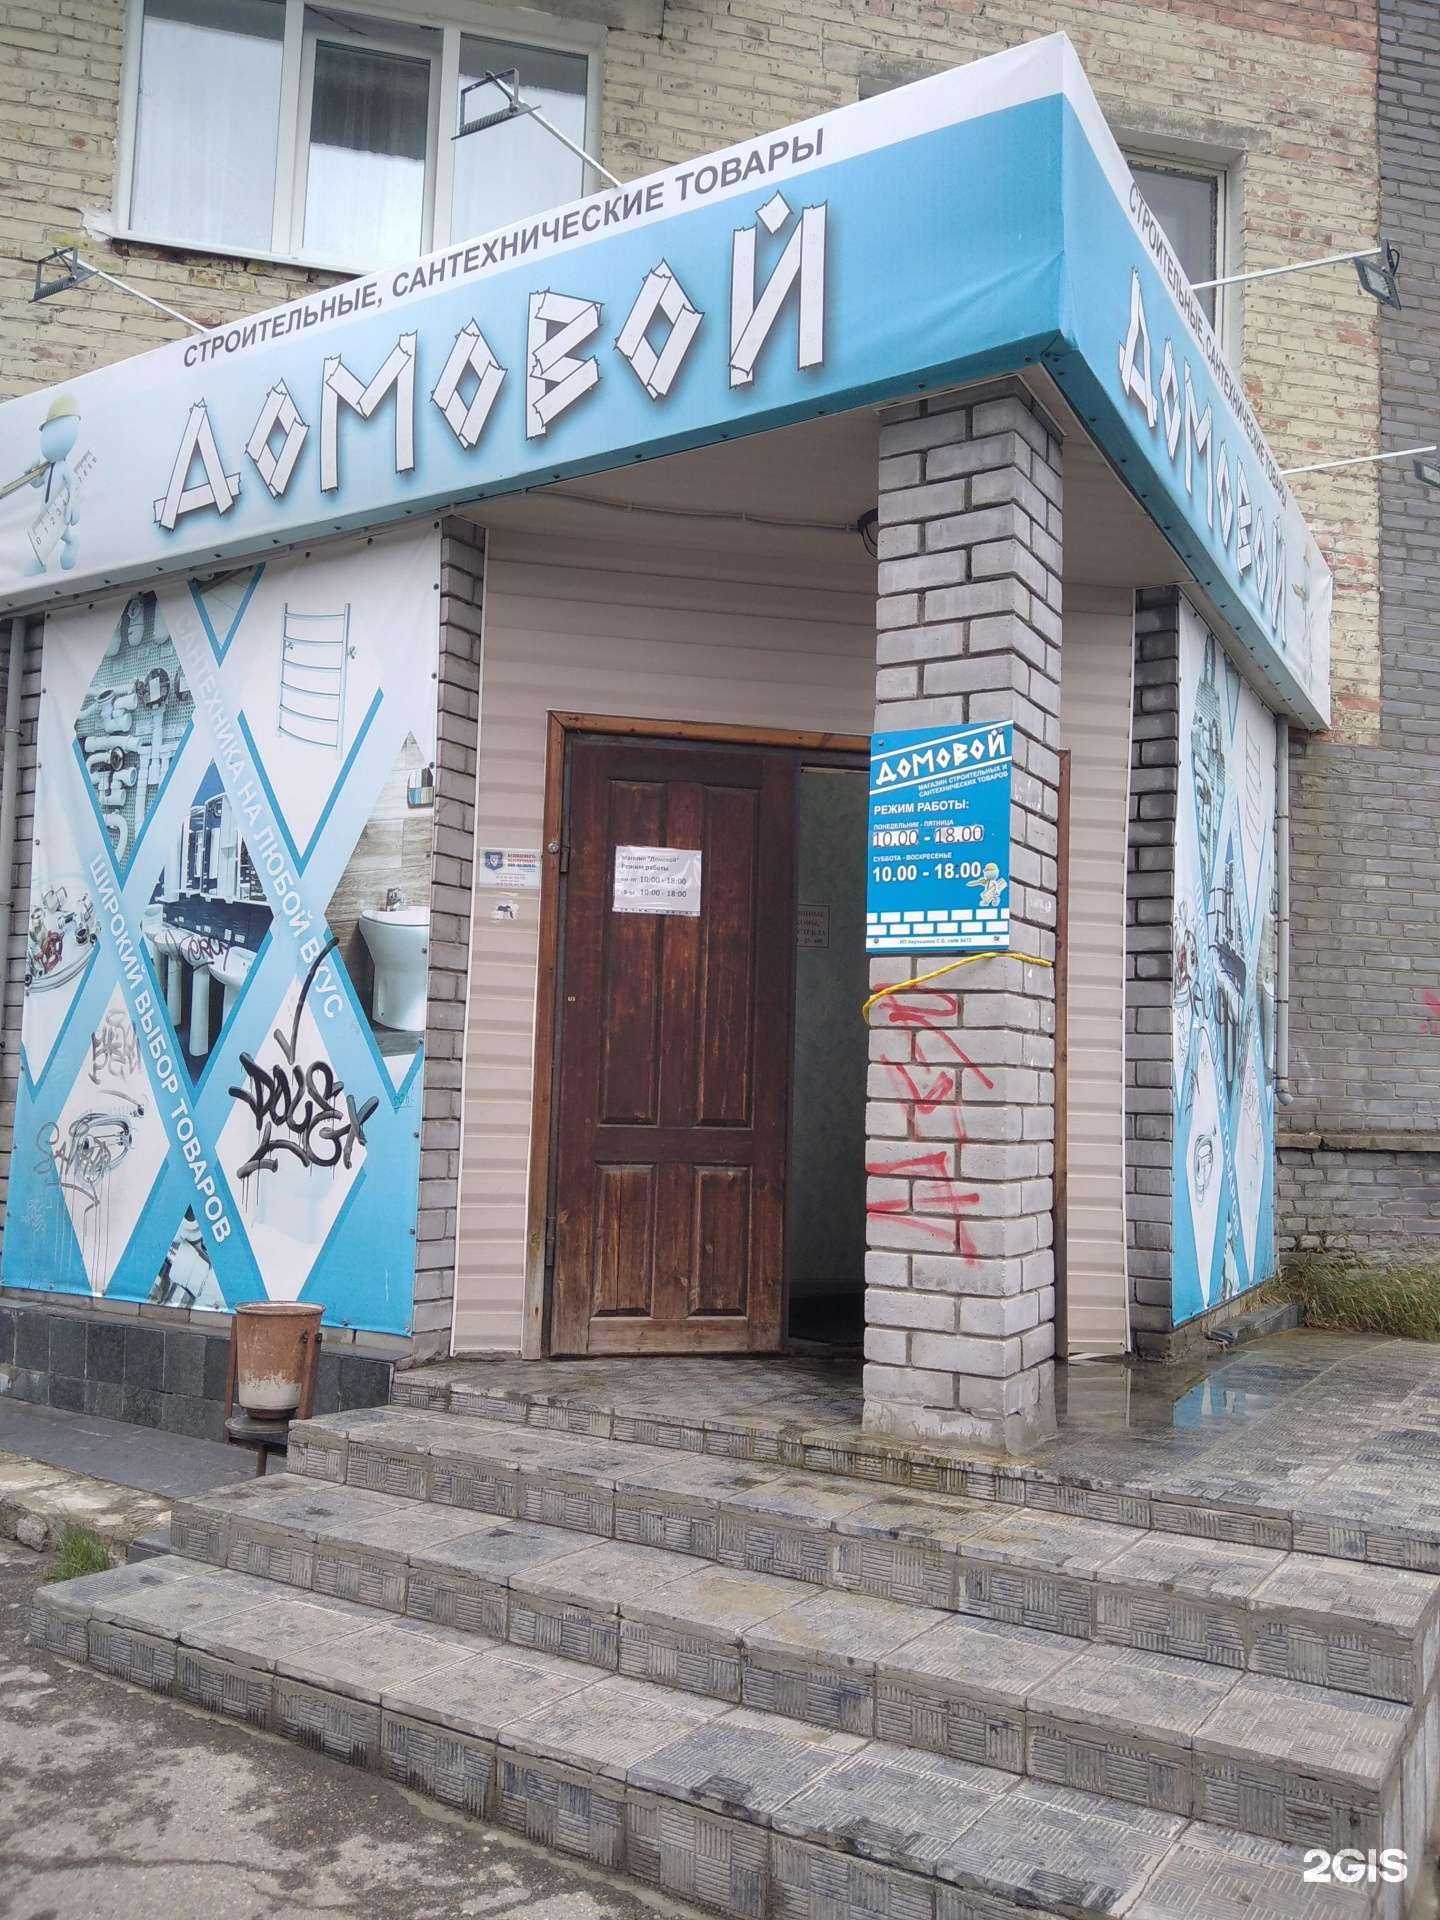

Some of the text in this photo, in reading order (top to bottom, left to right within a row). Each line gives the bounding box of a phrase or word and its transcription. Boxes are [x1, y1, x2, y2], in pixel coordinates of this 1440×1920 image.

[183, 127, 824, 368] СТРОИТЕЛЬНЫЕ, САНТЕХНИЧЕСКИЕ ТОВАРЫ
[152, 189, 830, 533] ДОМОВОЙ
[1118, 264, 1287, 650] ДОМОВОЙ
[174, 613, 245, 781] САНТЕХНИКА
[238, 781, 264, 828] НА
[253, 824, 314, 938] ЛЮБОЙ
[875, 729, 1007, 787] ДОМОВОЙ
[978, 770, 1009, 784] ТОВАРОВ
[918, 778, 948, 792] МАГАЗИН
[948, 767, 1002, 784] СТРОИТЕЛЬНЫХ
[873, 822, 919, 831] ПОНЕДЕЛЬНИК
[923, 819, 954, 828] ПЯТНИЦА
[874, 799, 970, 815] РЕЖИМ РАБОТЫ:
[873, 855, 901, 863] СУББОТА
[906, 852, 953, 861] ВОСКРЕСЕНЬЕ
[873, 865, 917, 882] 10.00
[934, 861, 981, 880] 18.00
[90, 856, 143, 990] ШИРОКИЙ
[134, 990, 179, 1096] ВЫБОР
[170, 1097, 232, 1243] ТОВАРОВ
